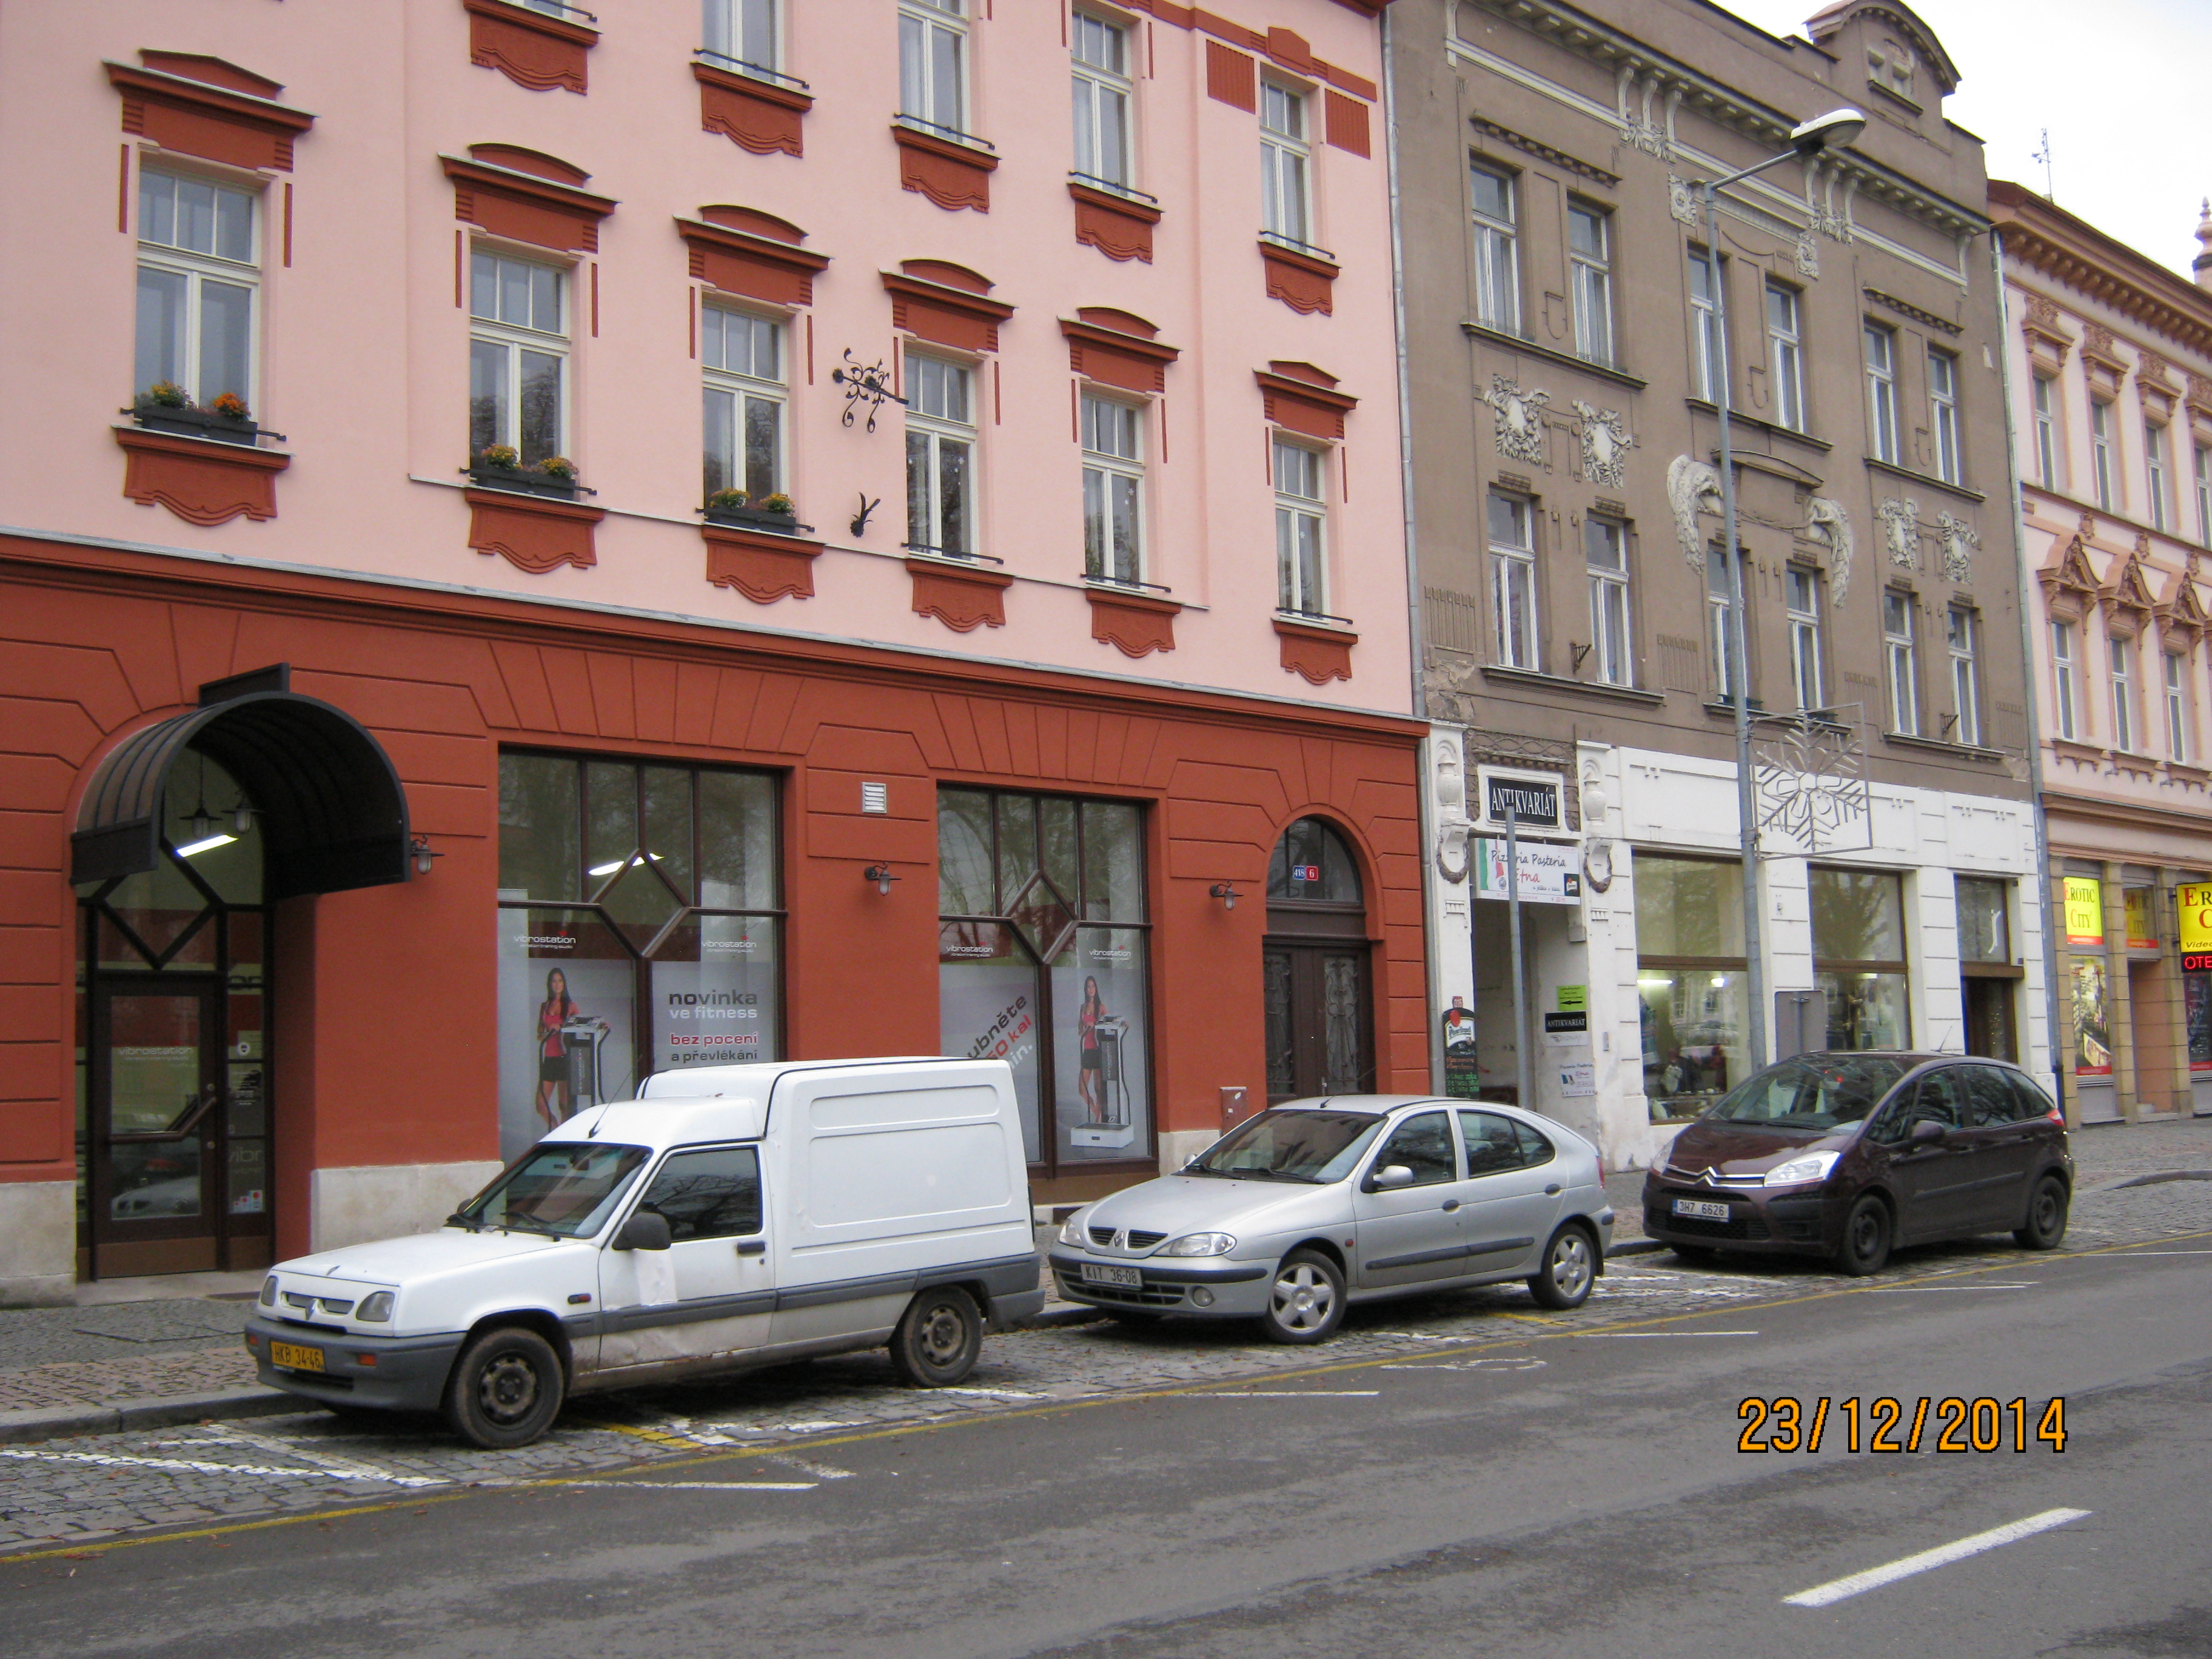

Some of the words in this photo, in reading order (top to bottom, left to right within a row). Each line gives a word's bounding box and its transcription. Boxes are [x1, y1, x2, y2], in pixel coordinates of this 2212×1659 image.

[1492, 786, 1555, 817] ANTIKVARIÁT
[1492, 850, 1529, 864] Pizria
[1532, 854, 1566, 867] Pasteria
[1309, 869, 1315, 878] 6
[2063, 882, 2095, 903] EROTIC
[2070, 909, 2091, 928] CITY
[514, 934, 577, 943] vibrostation
[669, 989, 757, 1005] novinka
[669, 1009, 690, 1019] ve
[694, 1006, 757, 1019] fitness
[1007, 1014, 1032, 1043] kal
[671, 1033, 700, 1045] bez
[703, 1031, 758, 1048] pocení
[683, 1050, 757, 1064] převlékání
[1680, 1201, 1695, 1213] 3H7
[1702, 1204, 1724, 1216] 6626
[1110, 1268, 1137, 1284] 36-08
